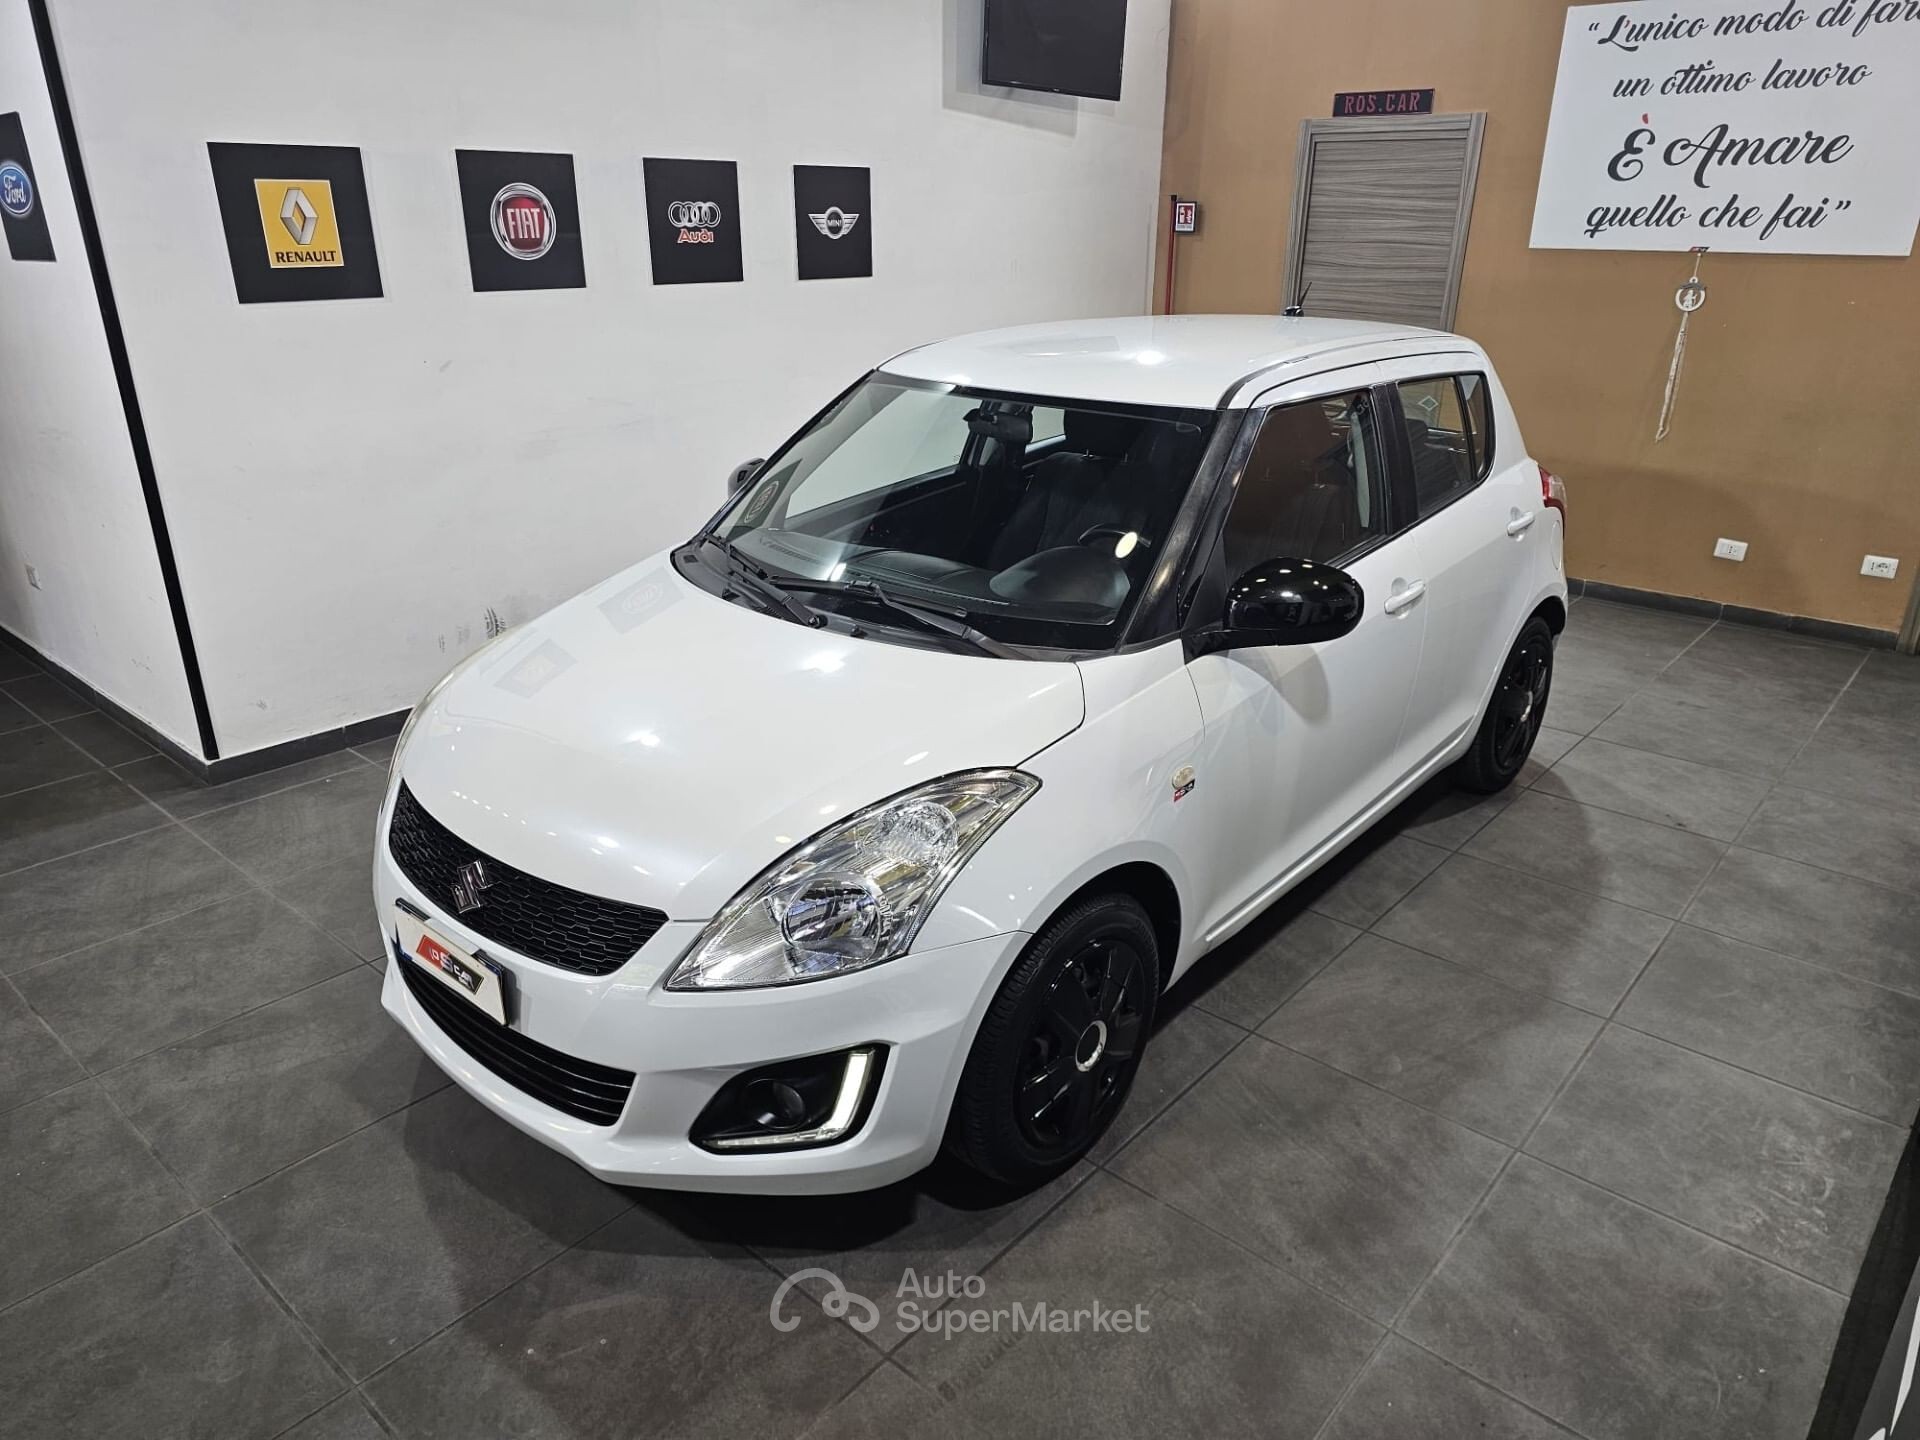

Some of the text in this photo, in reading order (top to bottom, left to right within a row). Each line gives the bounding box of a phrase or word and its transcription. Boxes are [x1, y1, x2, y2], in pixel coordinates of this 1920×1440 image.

[1713, 0, 1808, 36] modo
[1815, 0, 1856, 26] di
[1612, 58, 1873, 98] un ottimo lavoro
[1344, 92, 1421, 114] ROS.CAR
[1663, 124, 1855, 189] Amare
[3, 174, 27, 204] Ford
[506, 207, 541, 240] FIAT
[1584, 194, 1692, 239] quello
[1698, 194, 1763, 228] che
[677, 228, 714, 244] Audi
[275, 250, 337, 264] RENAULT
